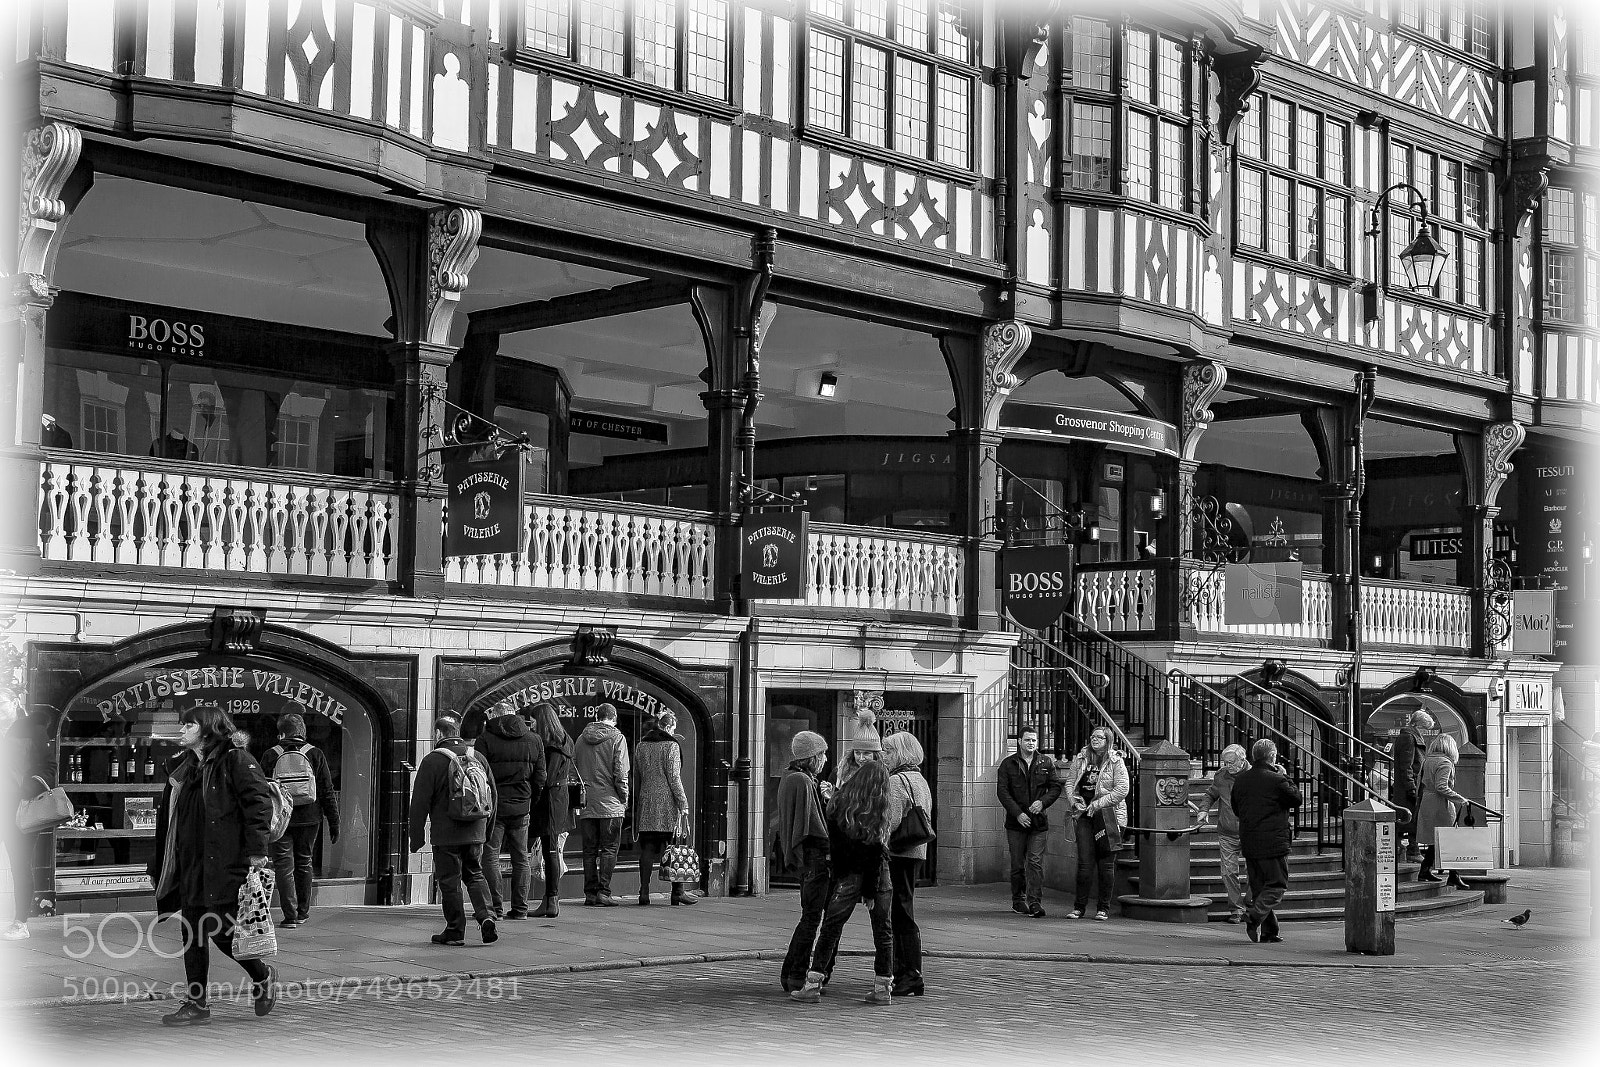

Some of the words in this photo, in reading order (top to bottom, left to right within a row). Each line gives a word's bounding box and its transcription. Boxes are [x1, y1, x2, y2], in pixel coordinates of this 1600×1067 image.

[128, 314, 205, 348] BOSS
[129, 341, 163, 351] HUGO
[171, 346, 204, 357] BOSS
[586, 420, 599, 430] OF
[601, 422, 642, 435] CHESTER
[1055, 413, 1108, 431] Grosvenor
[1109, 420, 1145, 440] Shopping
[1145, 427, 1164, 442] Centre
[1536, 465, 1575, 478] TESSUTI
[457, 471, 510, 495] PATISSERIE
[463, 523, 501, 539] VALERIE
[747, 526, 796, 545] PATISSERIE
[753, 571, 788, 586] VALERIE
[1009, 571, 1064, 592] BOSS
[1522, 613, 1550, 631] Moi?
[97, 666, 245, 724] PATISSERIE
[252, 669, 350, 725] VALERIE
[484, 677, 597, 720] PTISSERIE
[1521, 683, 1543, 709] Moi?
[226, 699, 260, 714] 1926
[559, 704, 579, 718] Est.
[80, 877, 91, 886] All
[105, 876, 134, 888] products
